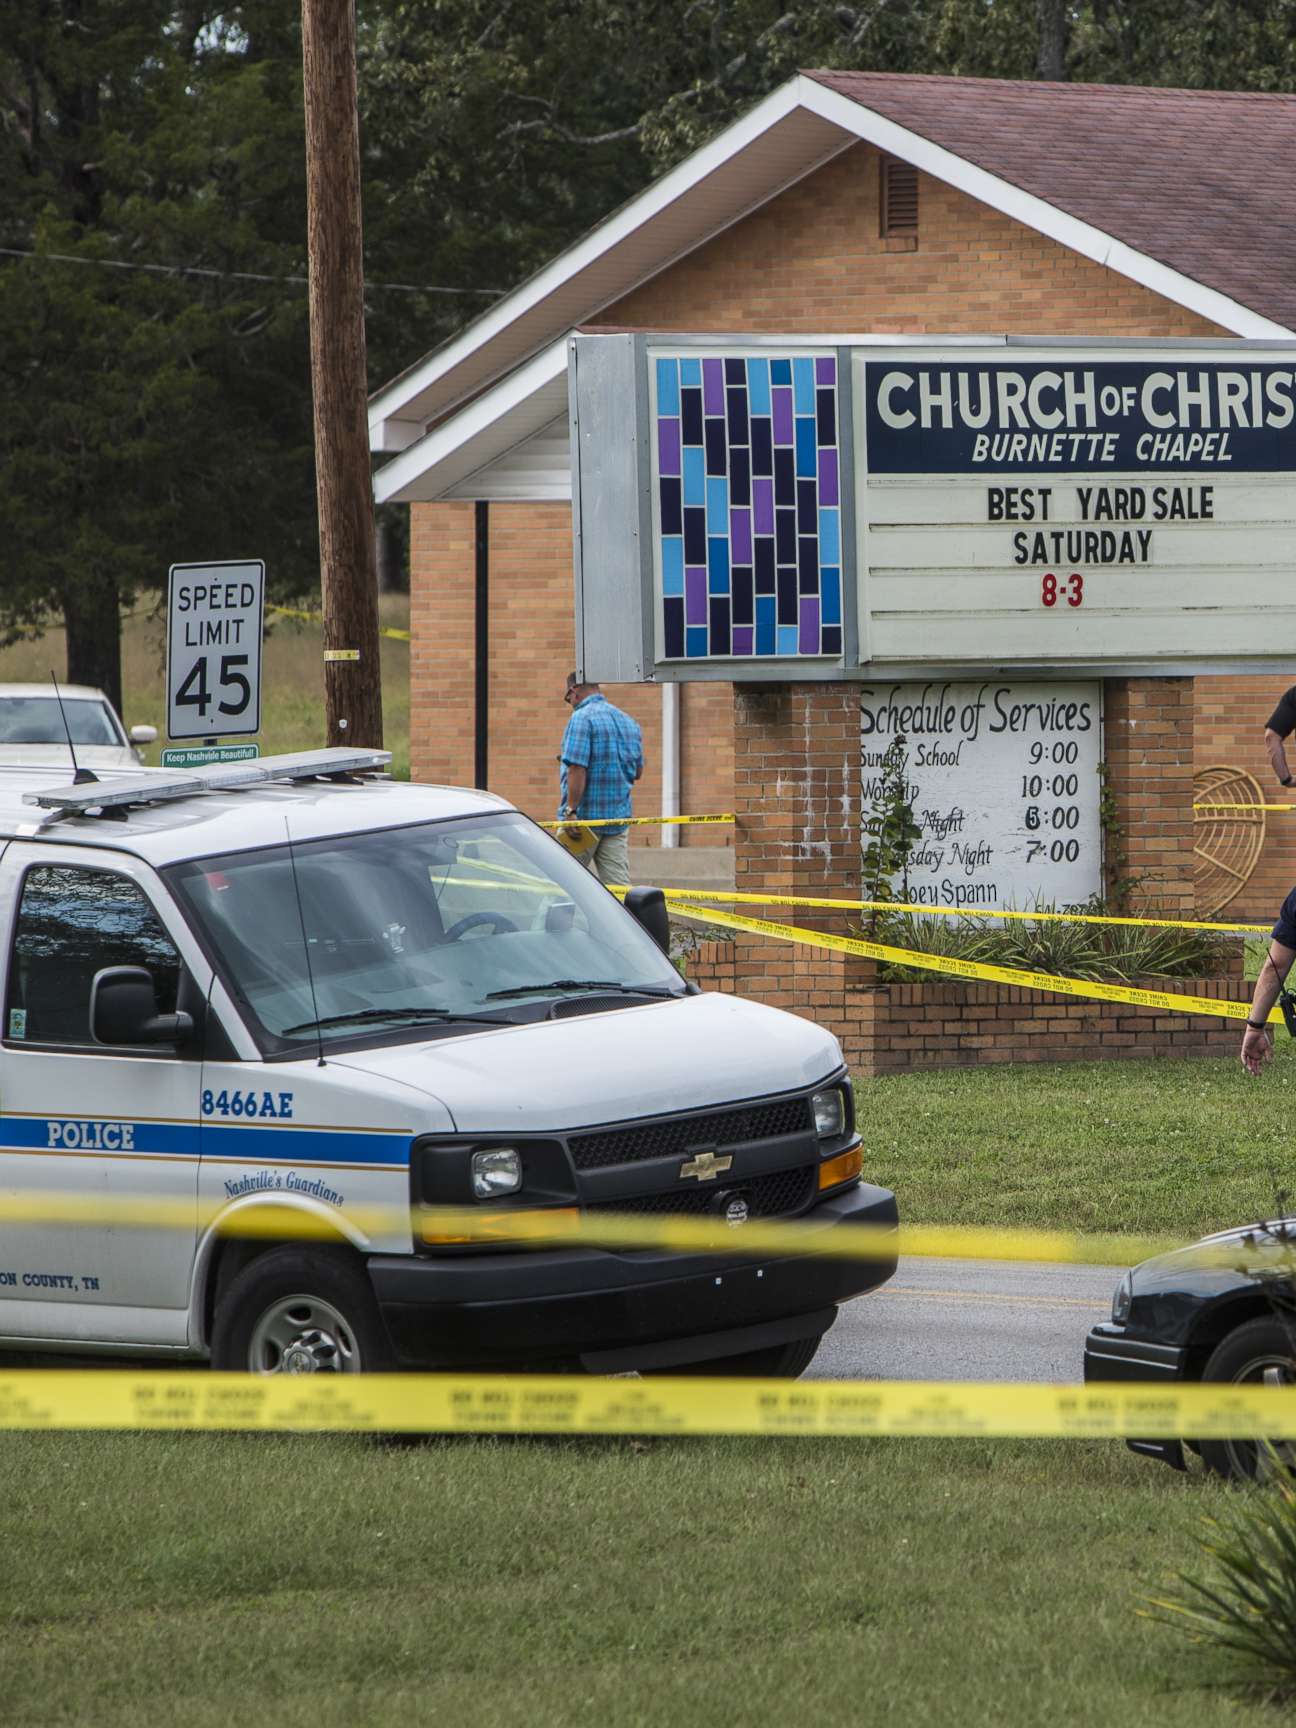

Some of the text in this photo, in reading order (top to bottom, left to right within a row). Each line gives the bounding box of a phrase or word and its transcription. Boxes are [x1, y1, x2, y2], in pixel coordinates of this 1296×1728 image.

[877, 371, 1097, 429] CHURCH
[1100, 387, 1137, 417] OF
[972, 432, 1233, 463] BURNETTE CHAPEL
[987, 486, 1214, 521] BEST YARD SALE
[1014, 530, 1153, 565] SATURDAY
[178, 583, 254, 612] SPEED
[1042, 573, 1084, 607] 8-3
[185, 619, 244, 646] LIMIT
[175, 654, 250, 717] 45
[861, 684, 1091, 741] Schedule of Services
[167, 748, 254, 763] Keep Nashville Beautiful!
[915, 740, 963, 767] School
[1029, 742, 1078, 764] 9:00
[1022, 775, 1078, 798] 10:00
[947, 840, 993, 876] Night
[1025, 839, 1080, 863] 7:00
[942, 879, 996, 908] Spann
[202, 1089, 294, 1119] 8466AE
[48, 1122, 134, 1150] POLICE
[224, 1170, 344, 1207] Nashville's Guardians
[23, 1273, 78, 1292] COUNTY,
[81, 1277, 99, 1290] TN
